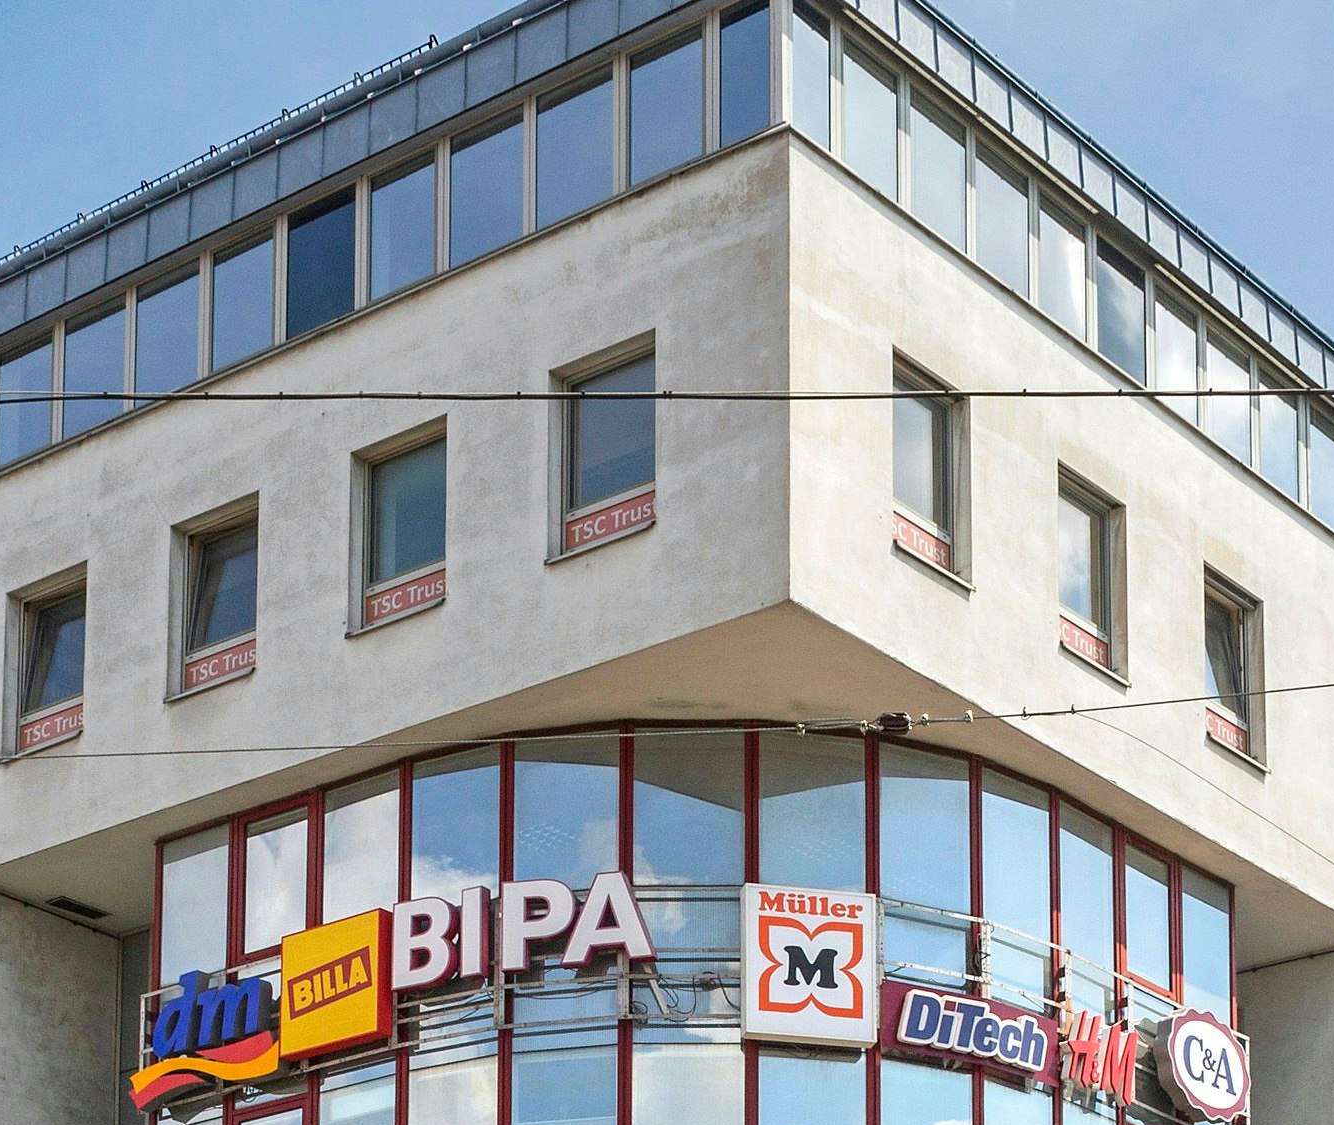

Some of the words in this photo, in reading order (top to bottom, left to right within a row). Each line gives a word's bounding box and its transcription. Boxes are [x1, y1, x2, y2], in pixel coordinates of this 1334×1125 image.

[572, 516, 606, 543] TSC
[911, 528, 946, 565] Trust
[371, 592, 403, 616] TSC
[1073, 628, 1104, 663] Trust
[190, 659, 219, 683] TSC
[24, 722, 51, 744] TSC
[1217, 715, 1244, 749] Trust
[759, 891, 863, 919] Müller
[392, 871, 657, 993] BIPA
[292, 955, 369, 1012] BILLA
[784, 945, 838, 989] M
[153, 970, 273, 1059] dm
[900, 991, 1048, 1071] DiTech
[1067, 1009, 1138, 1108] H&M
[1185, 1033, 1238, 1097] C&A
